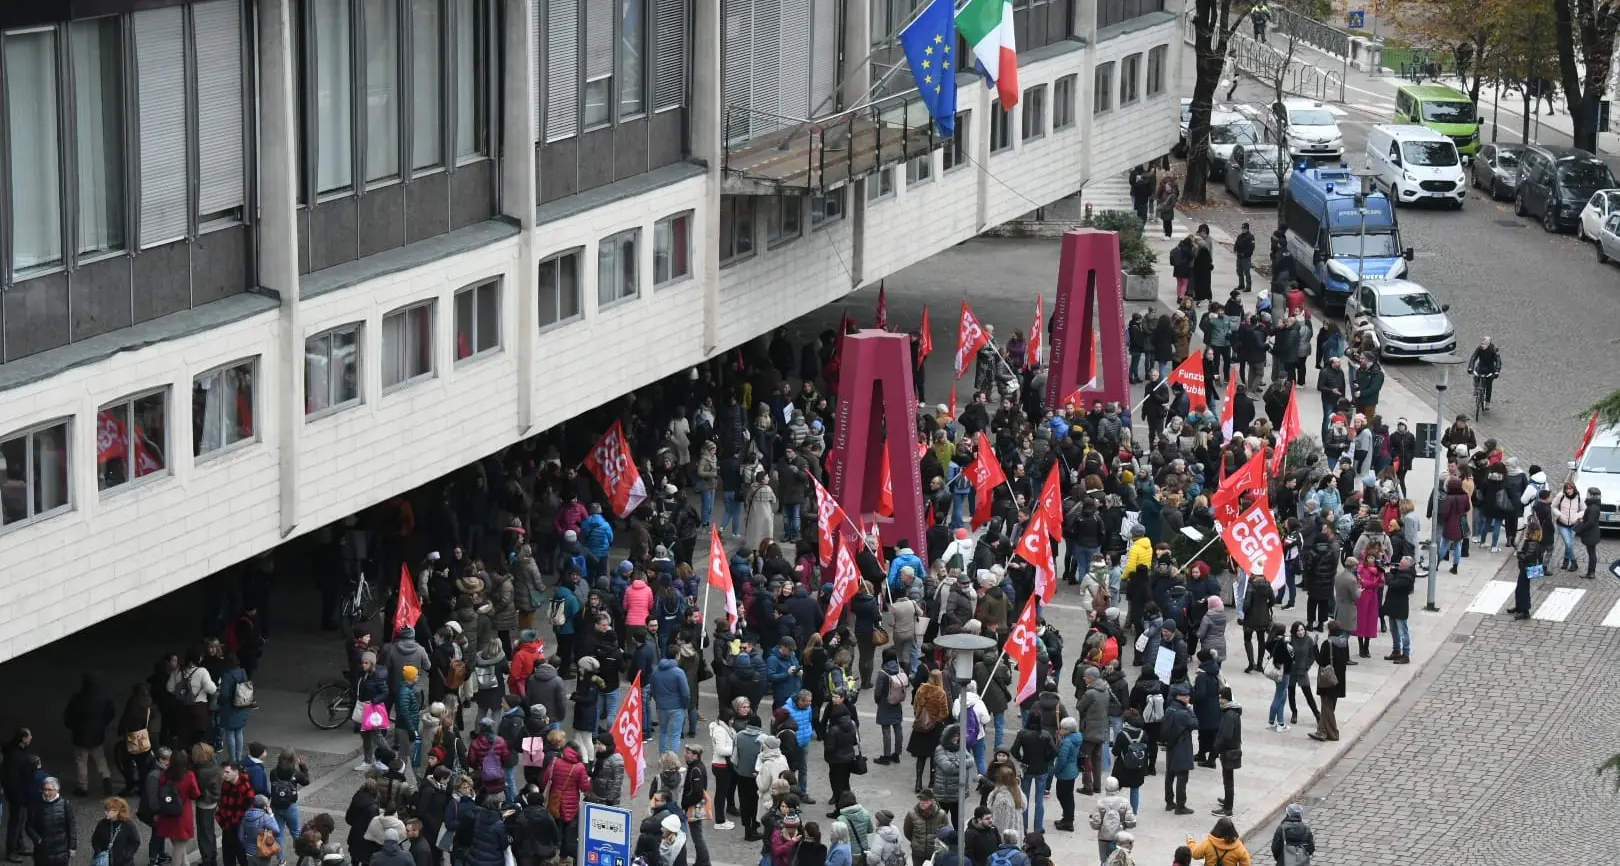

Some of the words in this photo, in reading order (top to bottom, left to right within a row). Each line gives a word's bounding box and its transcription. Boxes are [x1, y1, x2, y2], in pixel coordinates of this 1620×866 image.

[1056, 292, 1067, 330] Identity
[1053, 338, 1061, 364] Land
[1246, 507, 1279, 552] FLC
[619, 710, 638, 758] CGI
[590, 854, 597, 862] 2
